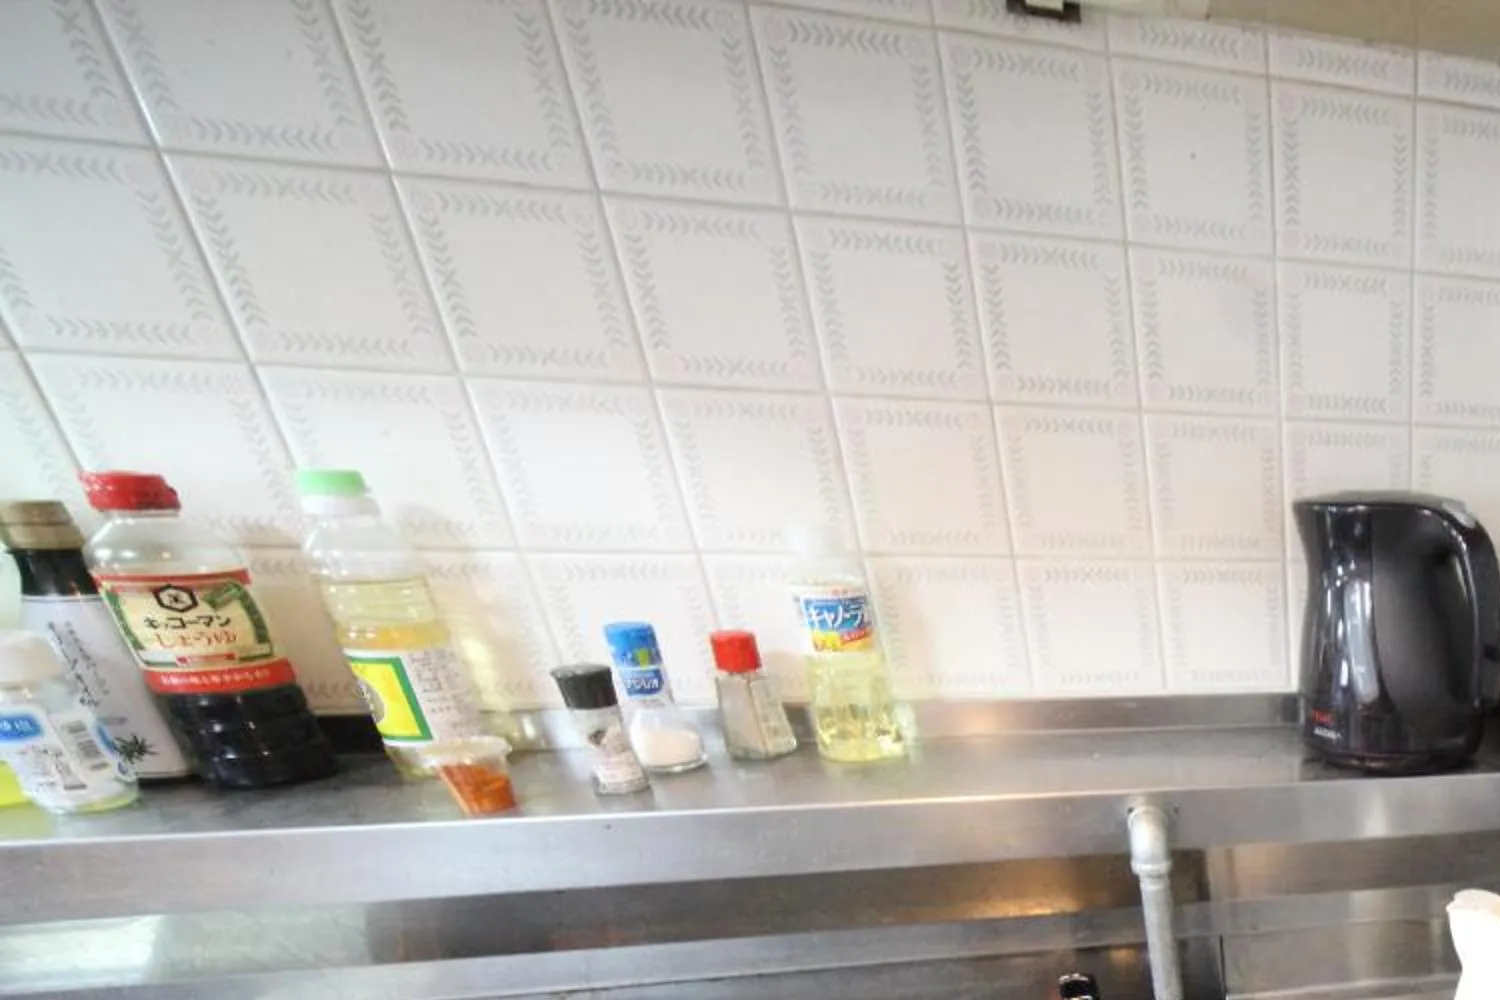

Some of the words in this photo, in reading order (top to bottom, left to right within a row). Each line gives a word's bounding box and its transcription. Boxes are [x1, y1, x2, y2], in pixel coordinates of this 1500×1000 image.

[144, 615, 231, 630] キッコーマン
[155, 631, 238, 648] しょうゆ
